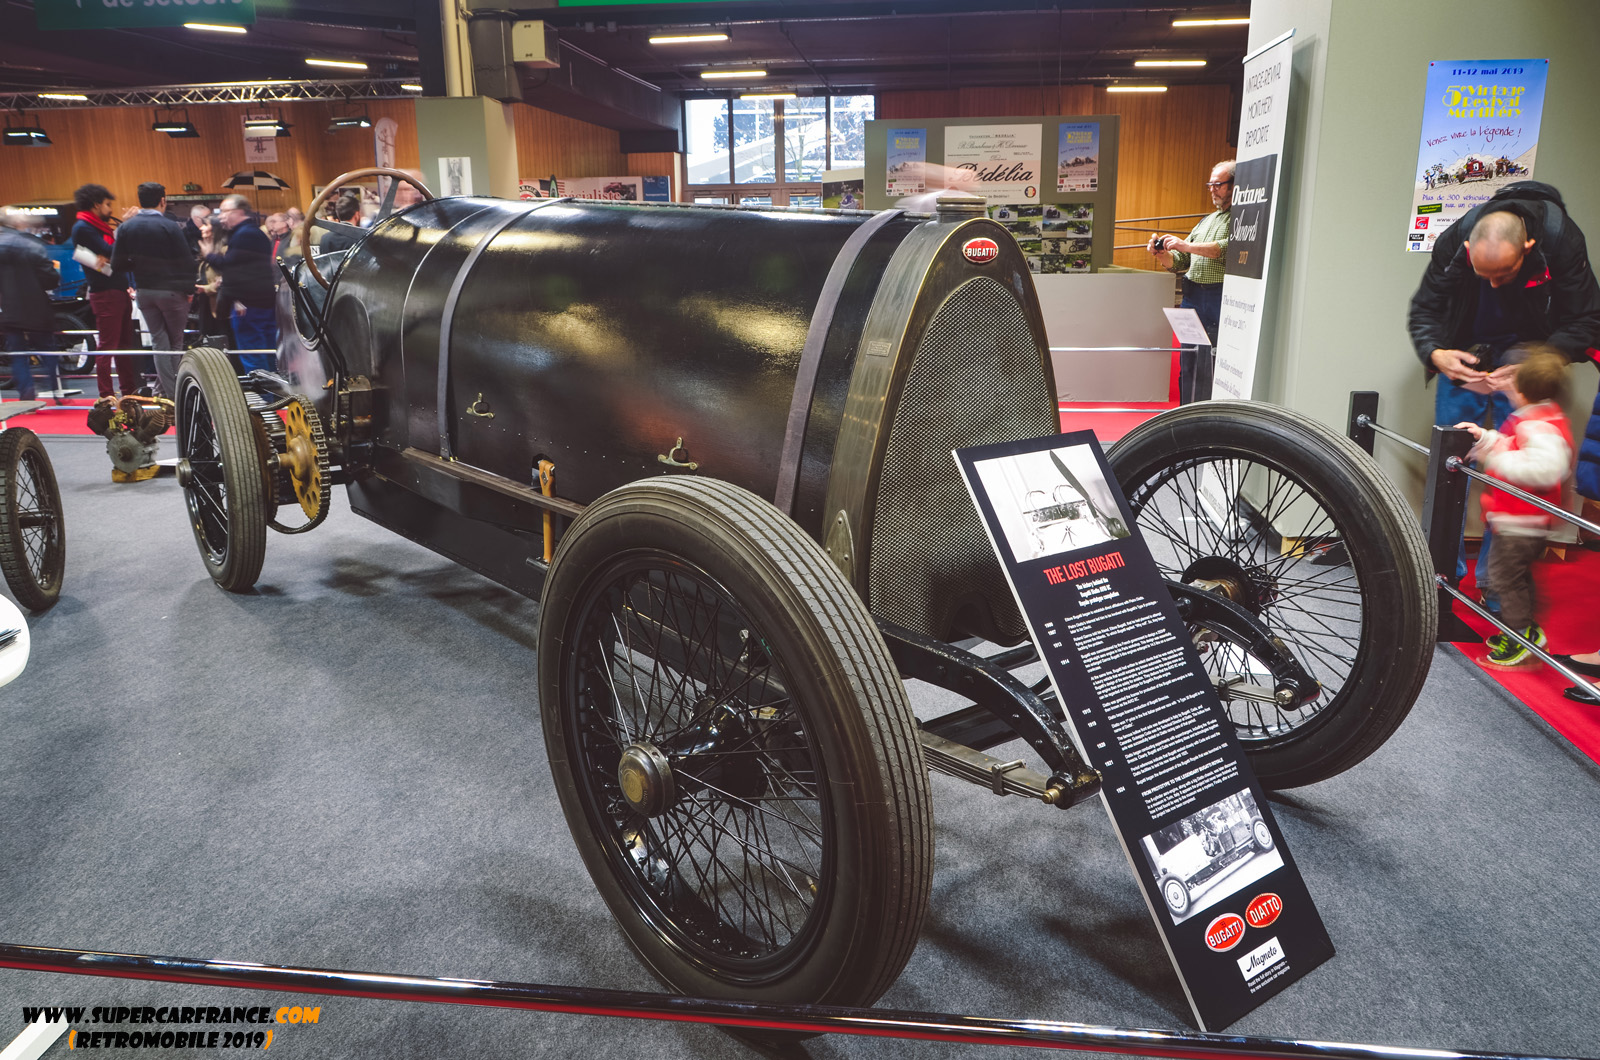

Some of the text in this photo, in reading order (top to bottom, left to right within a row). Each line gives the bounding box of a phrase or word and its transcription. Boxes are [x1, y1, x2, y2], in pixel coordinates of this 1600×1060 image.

[1462, 95, 1520, 108] Revival
[1467, 85, 1525, 97] Vintage
[1446, 106, 1525, 119] Montlhéry
[1231, 184, 1268, 206] Octane
[967, 247, 996, 257] BUGATTI
[1043, 551, 1126, 585] THE LOST BUGATTI
[1249, 896, 1280, 924] DIATTO
[1208, 920, 1243, 947] BUGATTI
[1246, 946, 1278, 973] Magneto
